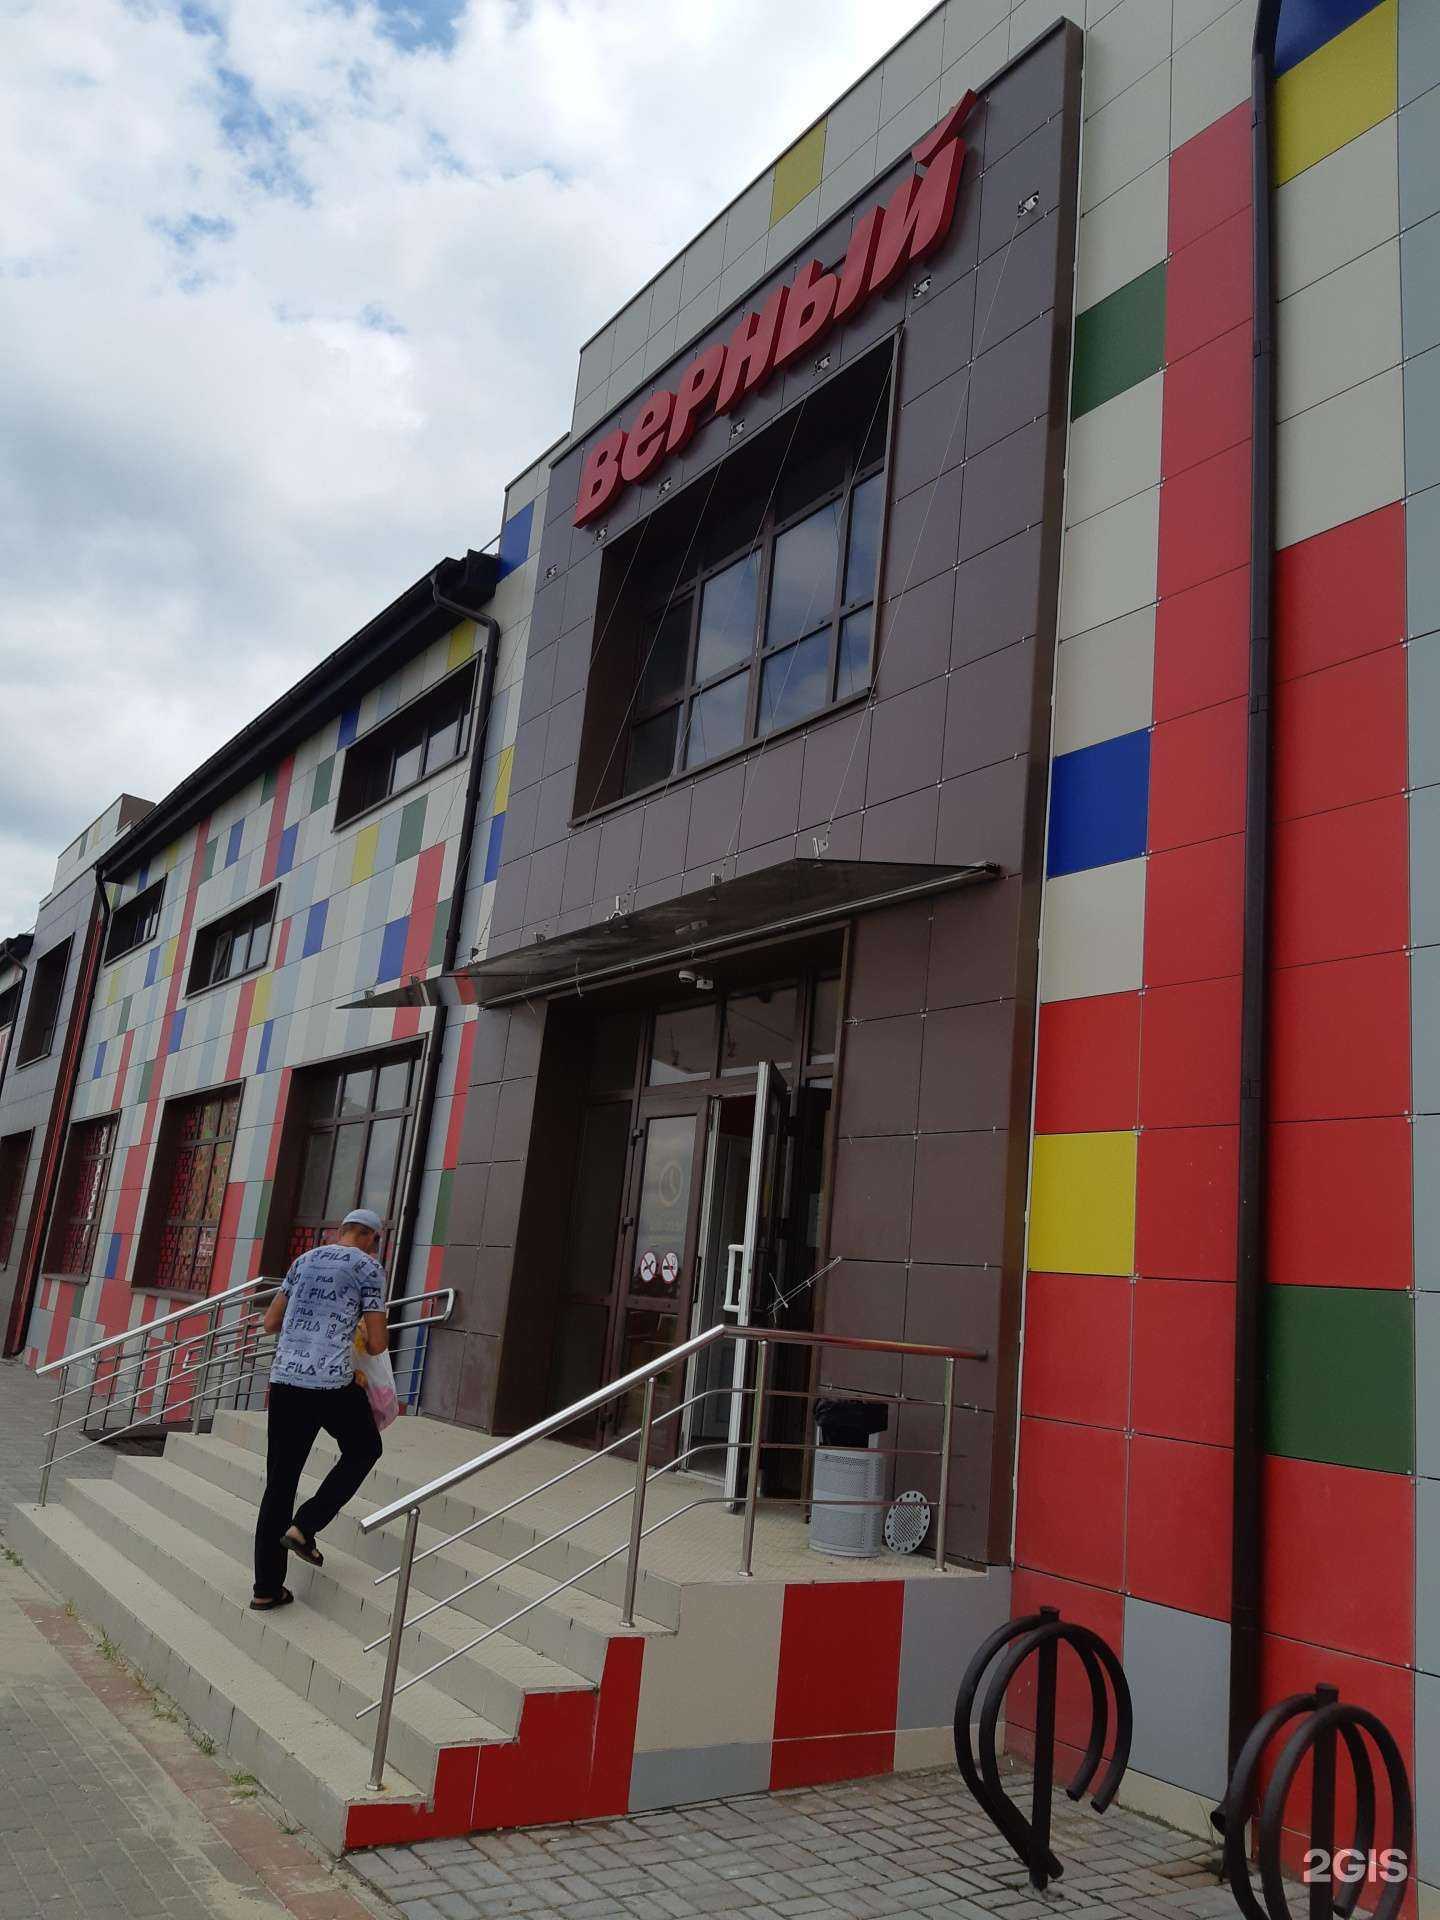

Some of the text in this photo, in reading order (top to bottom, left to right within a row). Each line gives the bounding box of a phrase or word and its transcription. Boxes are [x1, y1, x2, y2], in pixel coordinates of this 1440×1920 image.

[320, 1252, 351, 1262] FILA
[316, 1275, 334, 1283] FILA
[309, 1288, 336, 1300] FILA
[296, 1307, 314, 1316] FILA
[294, 1318, 321, 1332] FILA
[294, 1350, 310, 1358] FILA
[285, 1361, 317, 1377] FILA
